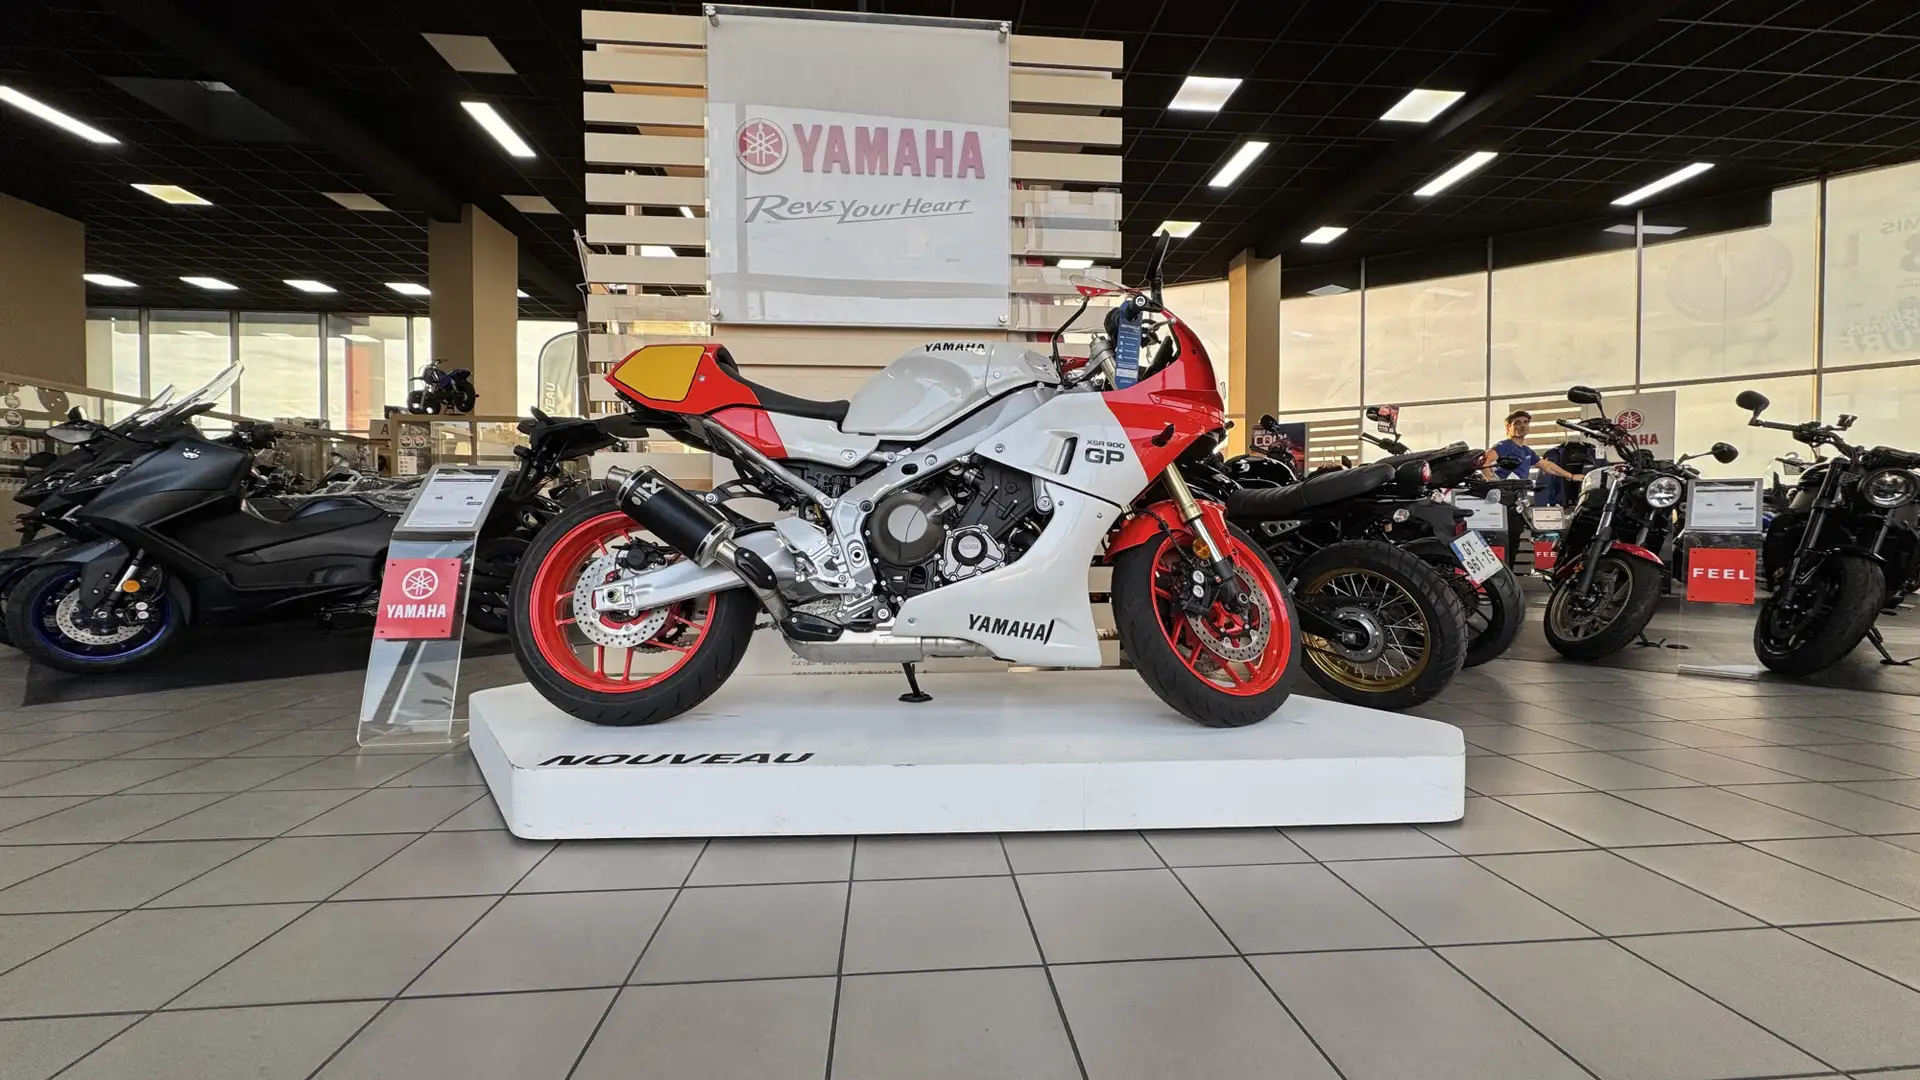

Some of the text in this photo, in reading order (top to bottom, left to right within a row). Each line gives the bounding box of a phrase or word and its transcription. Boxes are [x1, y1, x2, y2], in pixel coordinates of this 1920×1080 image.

[792, 123, 986, 180] YAMAHA
[743, 194, 973, 225] Revs Your Heart
[924, 342, 986, 353] YAMAHA
[1086, 439, 1126, 449] XSR 900
[1085, 447, 1125, 465] GP
[1692, 567, 1750, 580] FEEL
[386, 603, 447, 619] YAMAHA
[968, 613, 1047, 642] YAMAHA
[537, 752, 816, 767] NOUVEAU
